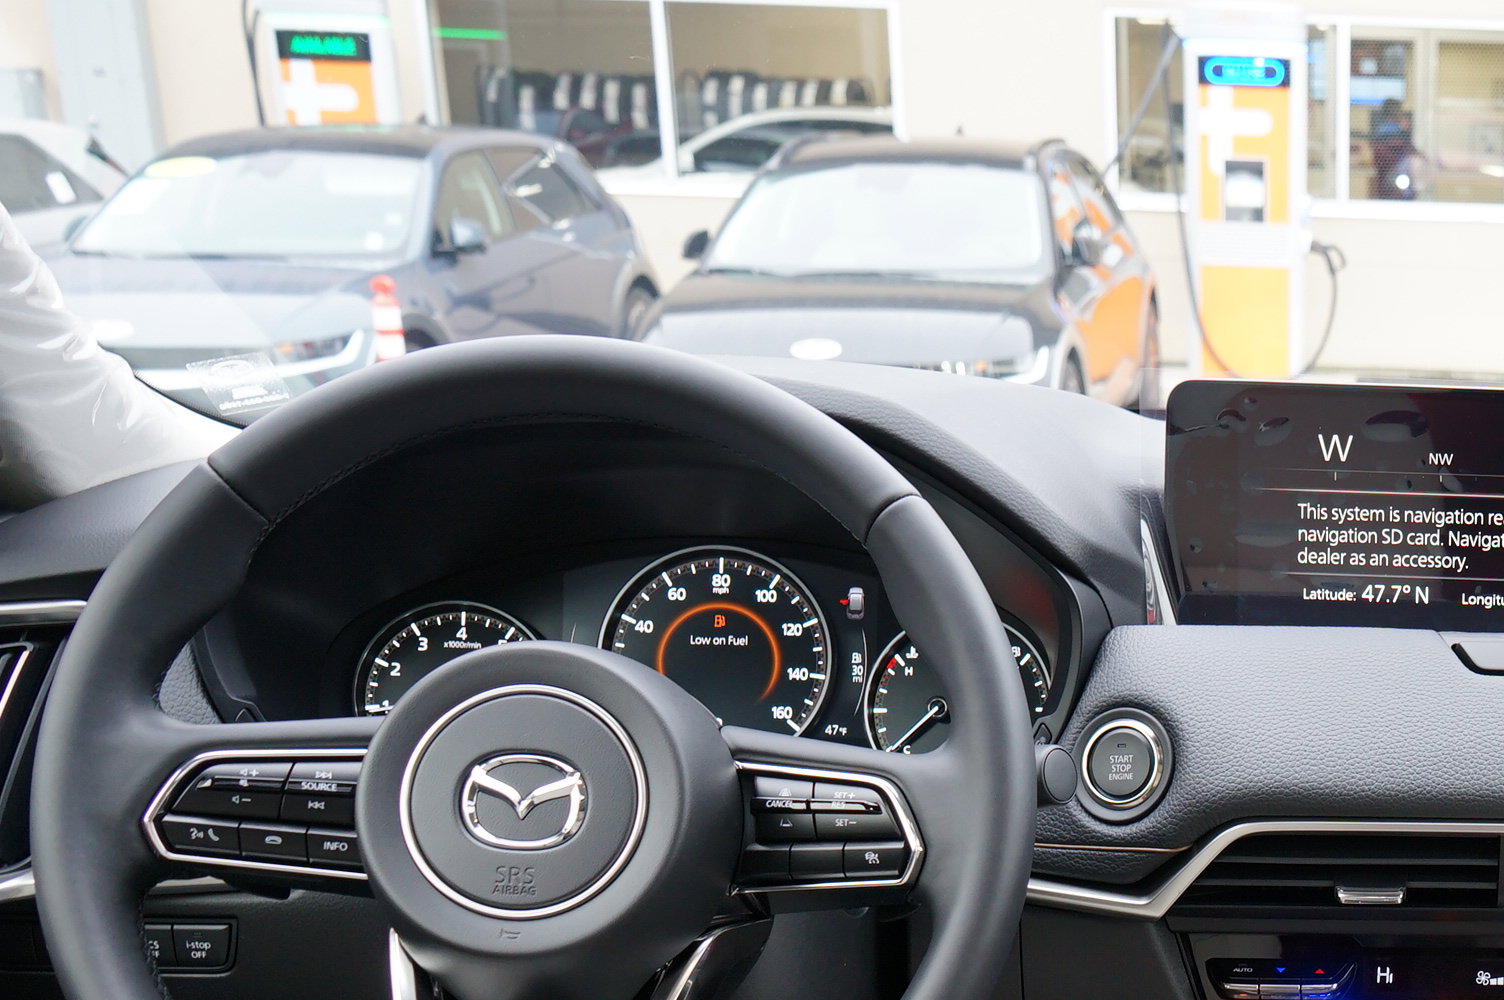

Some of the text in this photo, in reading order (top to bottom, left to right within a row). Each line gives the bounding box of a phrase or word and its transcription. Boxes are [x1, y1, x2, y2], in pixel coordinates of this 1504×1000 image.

[1318, 434, 1354, 462] W
[1428, 453, 1453, 466] NW
[1298, 502, 1328, 520] This
[1331, 507, 1385, 523] system
[1389, 506, 1400, 522] is
[1404, 508, 1484, 527] navigation
[1298, 527, 1378, 546] navigation
[1382, 529, 1403, 544] SD
[1407, 530, 1444, 546] card.
[1298, 548, 1469, 572] dealer as an accessory.
[711, 574, 731, 587] 80
[668, 588, 686, 600] 60
[712, 586, 729, 594] mph
[755, 590, 777, 603] 100
[1303, 585, 1430, 604] Latitude: 47.7° N
[635, 620, 653, 633] 40
[782, 623, 802, 636] 120
[456, 627, 468, 640] 4
[418, 637, 428, 651] 3
[690, 635, 748, 646] Low on Fuel
[390, 662, 400, 676] 2
[787, 668, 808, 680] 140
[852, 667, 863, 675] 30
[905, 667, 913, 676] H
[771, 706, 792, 719] 160
[1110, 755, 1133, 763] START
[1112, 764, 1132, 772] STOP
[301, 782, 337, 792] SOURCE
[323, 841, 348, 851] INFO
[495, 865, 535, 884] SRS
[492, 885, 537, 895] AIRBAG
[186, 940, 211, 950] i-stop
[191, 951, 206, 959] OFF
